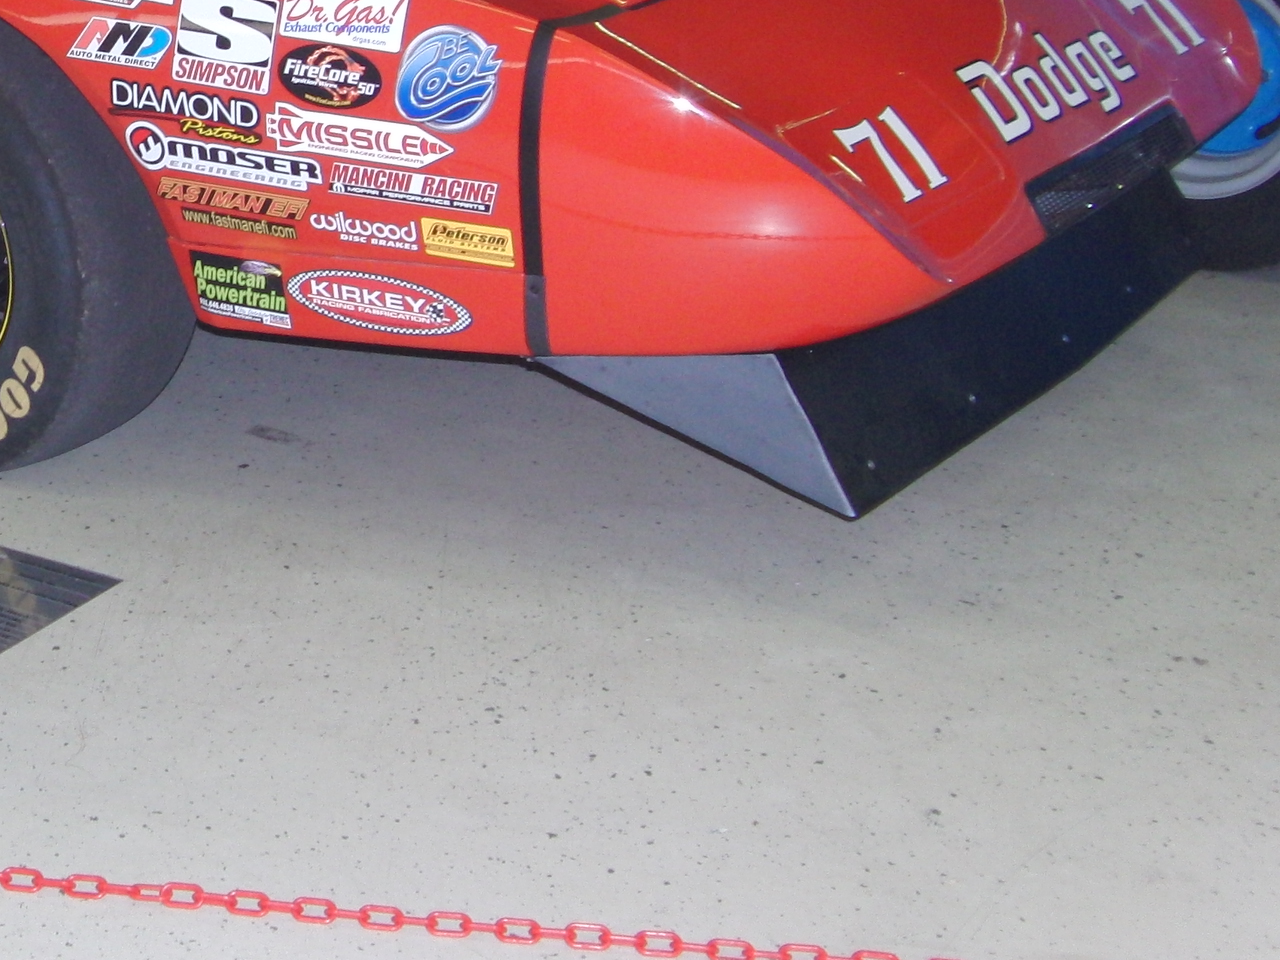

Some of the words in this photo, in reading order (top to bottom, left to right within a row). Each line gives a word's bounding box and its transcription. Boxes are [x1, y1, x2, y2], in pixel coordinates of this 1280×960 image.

[283, 21, 322, 33] Exhaust
[325, 22, 390, 36] Components
[352, 35, 387, 47] drgas.com
[70, 49, 93, 59] AUTO
[94, 53, 122, 63] METAL
[123, 56, 156, 68] DIRECT
[441, 33, 470, 60] BE
[175, 57, 266, 92] SIMPSON
[283, 58, 361, 85] FireCore
[290, 76, 317, 86] Ignition
[396, 41, 503, 121] COOL
[955, 29, 1138, 144] Dodge
[112, 80, 259, 128] DIAMOND
[180, 118, 260, 145] Pistons
[278, 118, 422, 157] MISSILE
[168, 139, 320, 180] MOSER
[307, 143, 348, 153] ENGINEERED
[350, 149, 376, 158] RACING
[377, 153, 425, 164] COMPONENTS
[833, 105, 949, 203] 71
[331, 164, 413, 192] MANCINI
[421, 177, 496, 204] RACING
[347, 186, 380, 197] MOPAR
[382, 191, 451, 206] PERFORMANCE
[453, 201, 486, 211] PARTS
[157, 180, 263, 214] FASTMAN
[267, 197, 310, 220] EFI
[182, 208, 298, 239] www.fastmanefi.com
[310, 211, 417, 242] wilwood
[431, 224, 506, 246] Peterson
[340, 234, 367, 244] DISC
[371, 238, 419, 251] BRAKES
[194, 260, 266, 289] American
[197, 279, 286, 312] Powertrain
[310, 280, 426, 313] KIRKEY
[313, 298, 355, 311] RACING
[358, 306, 431, 324] FABRICATION
